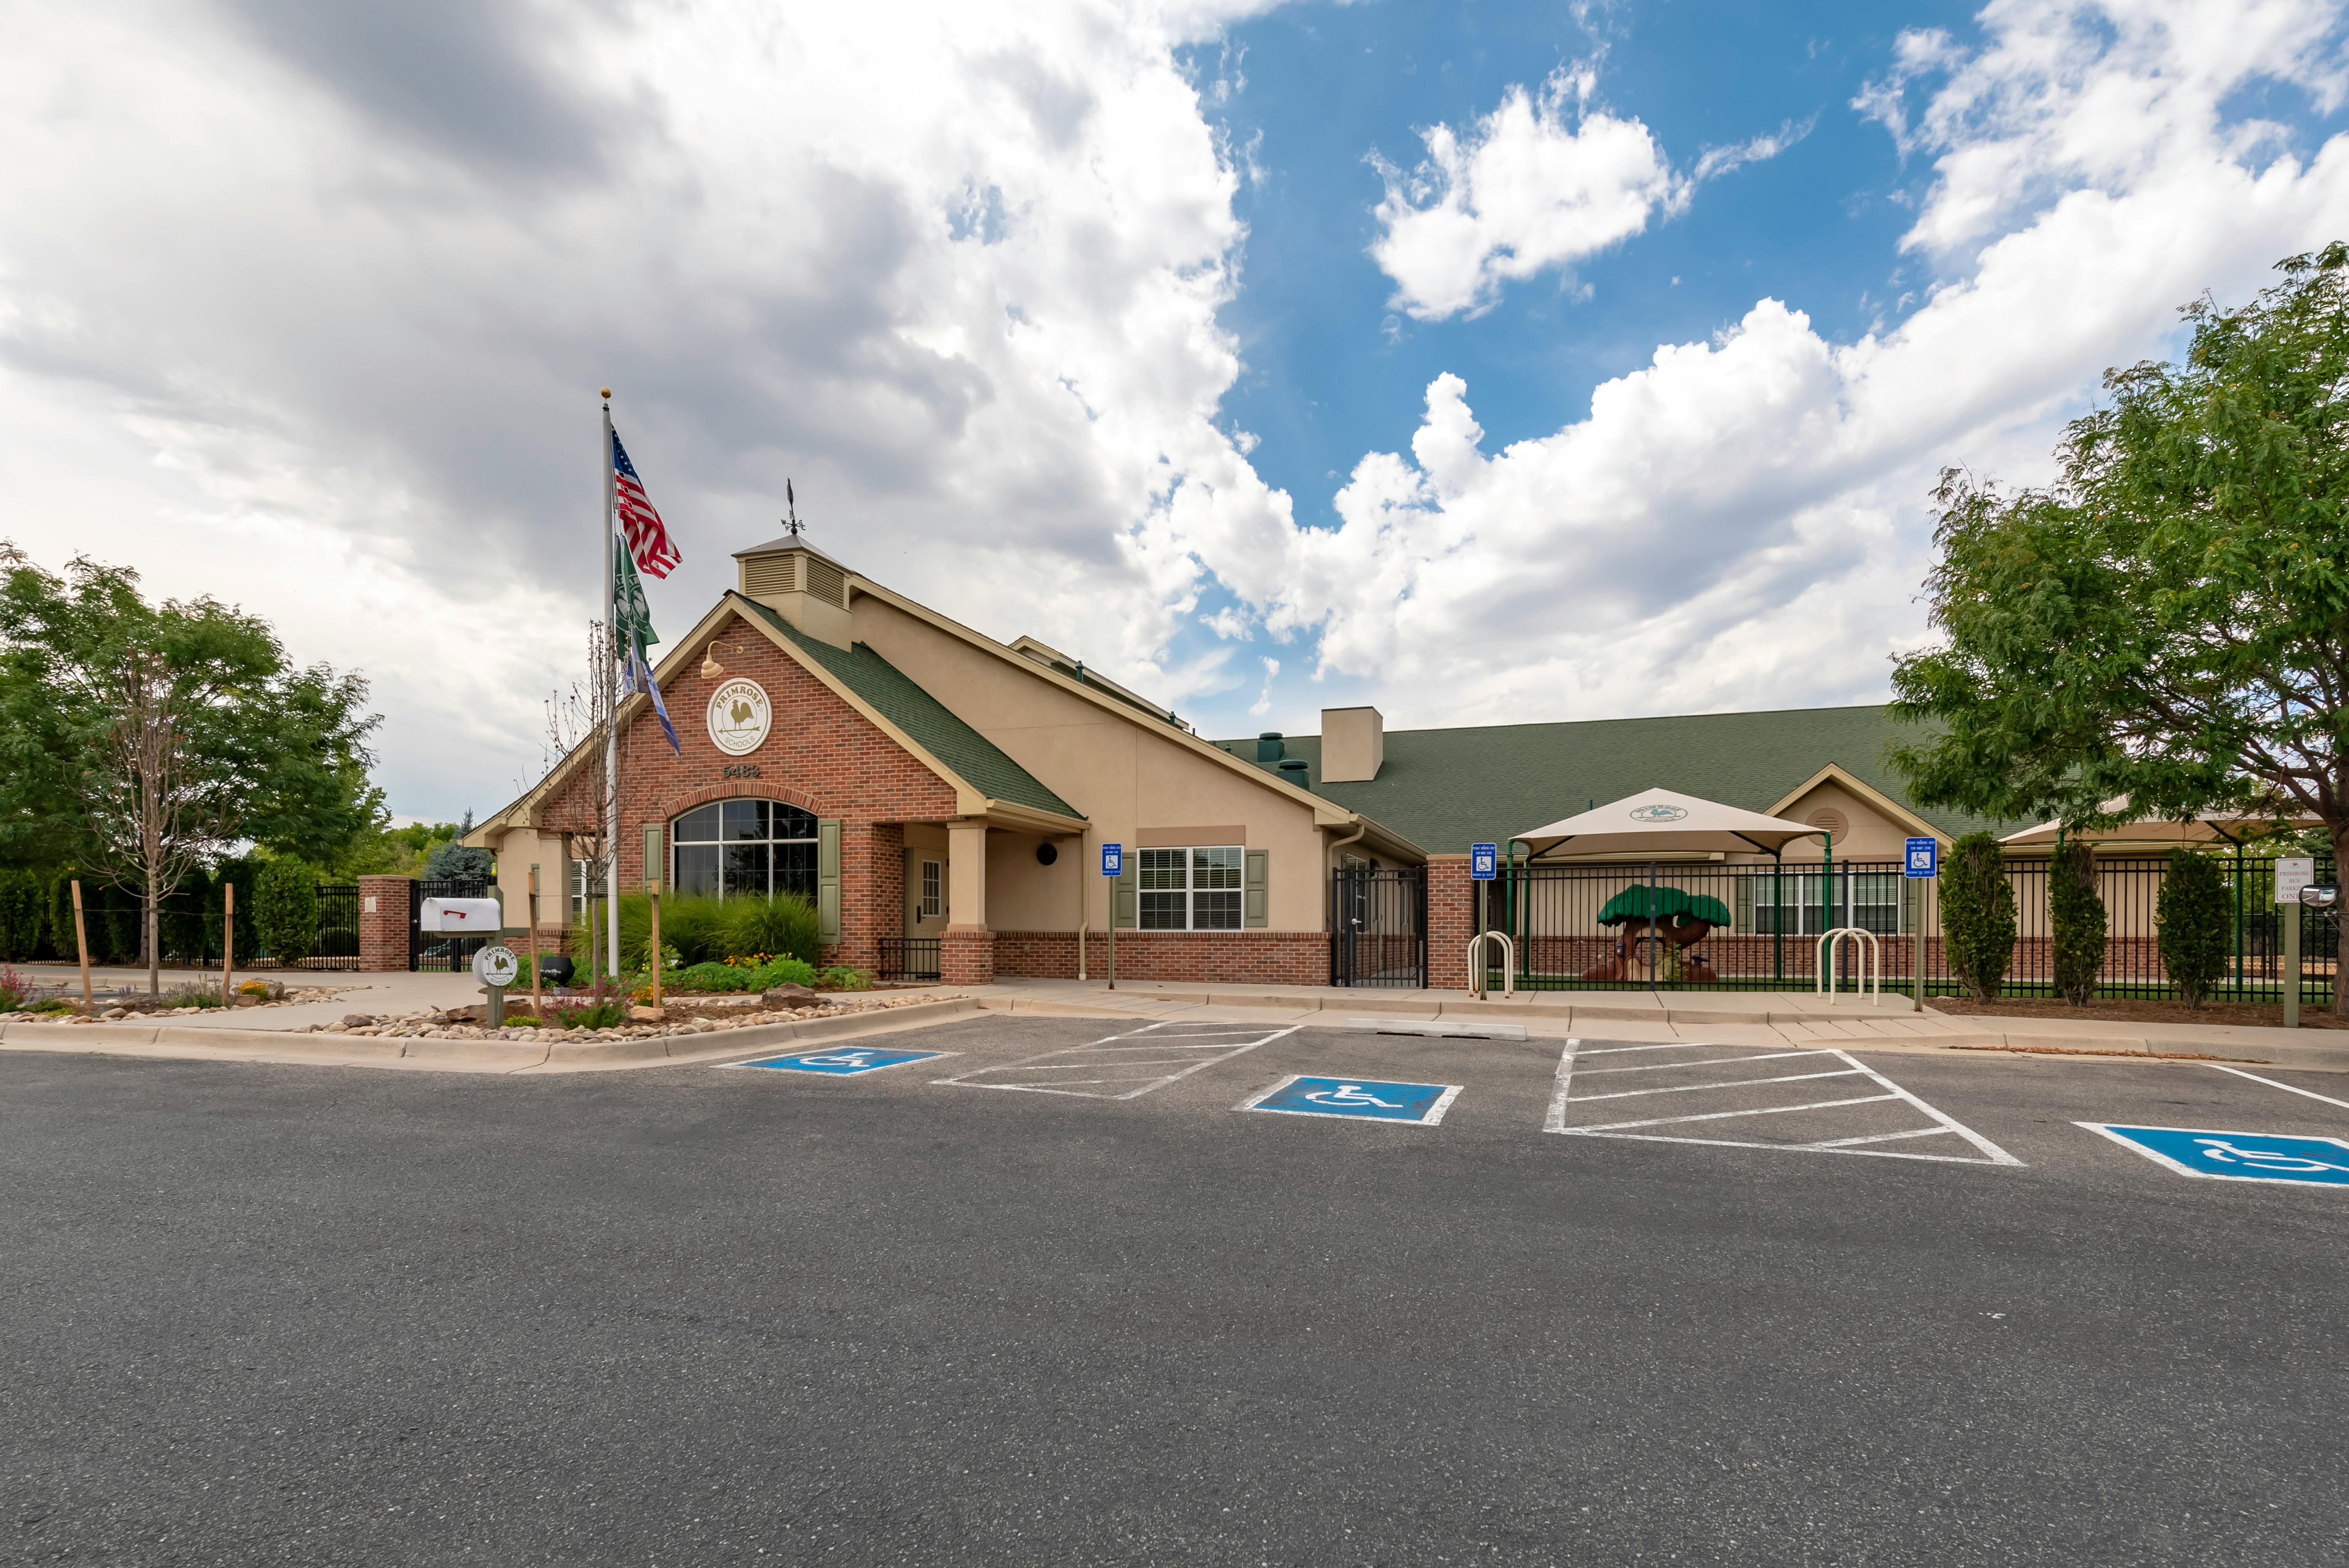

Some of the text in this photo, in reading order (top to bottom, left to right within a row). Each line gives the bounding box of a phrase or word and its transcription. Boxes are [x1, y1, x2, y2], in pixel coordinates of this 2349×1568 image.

[716, 686, 763, 710] PRIMROSE
[725, 736, 755, 747] SCHOOLS
[723, 765, 759, 778] 5483
[484, 948, 515, 961] PRIMROSE
